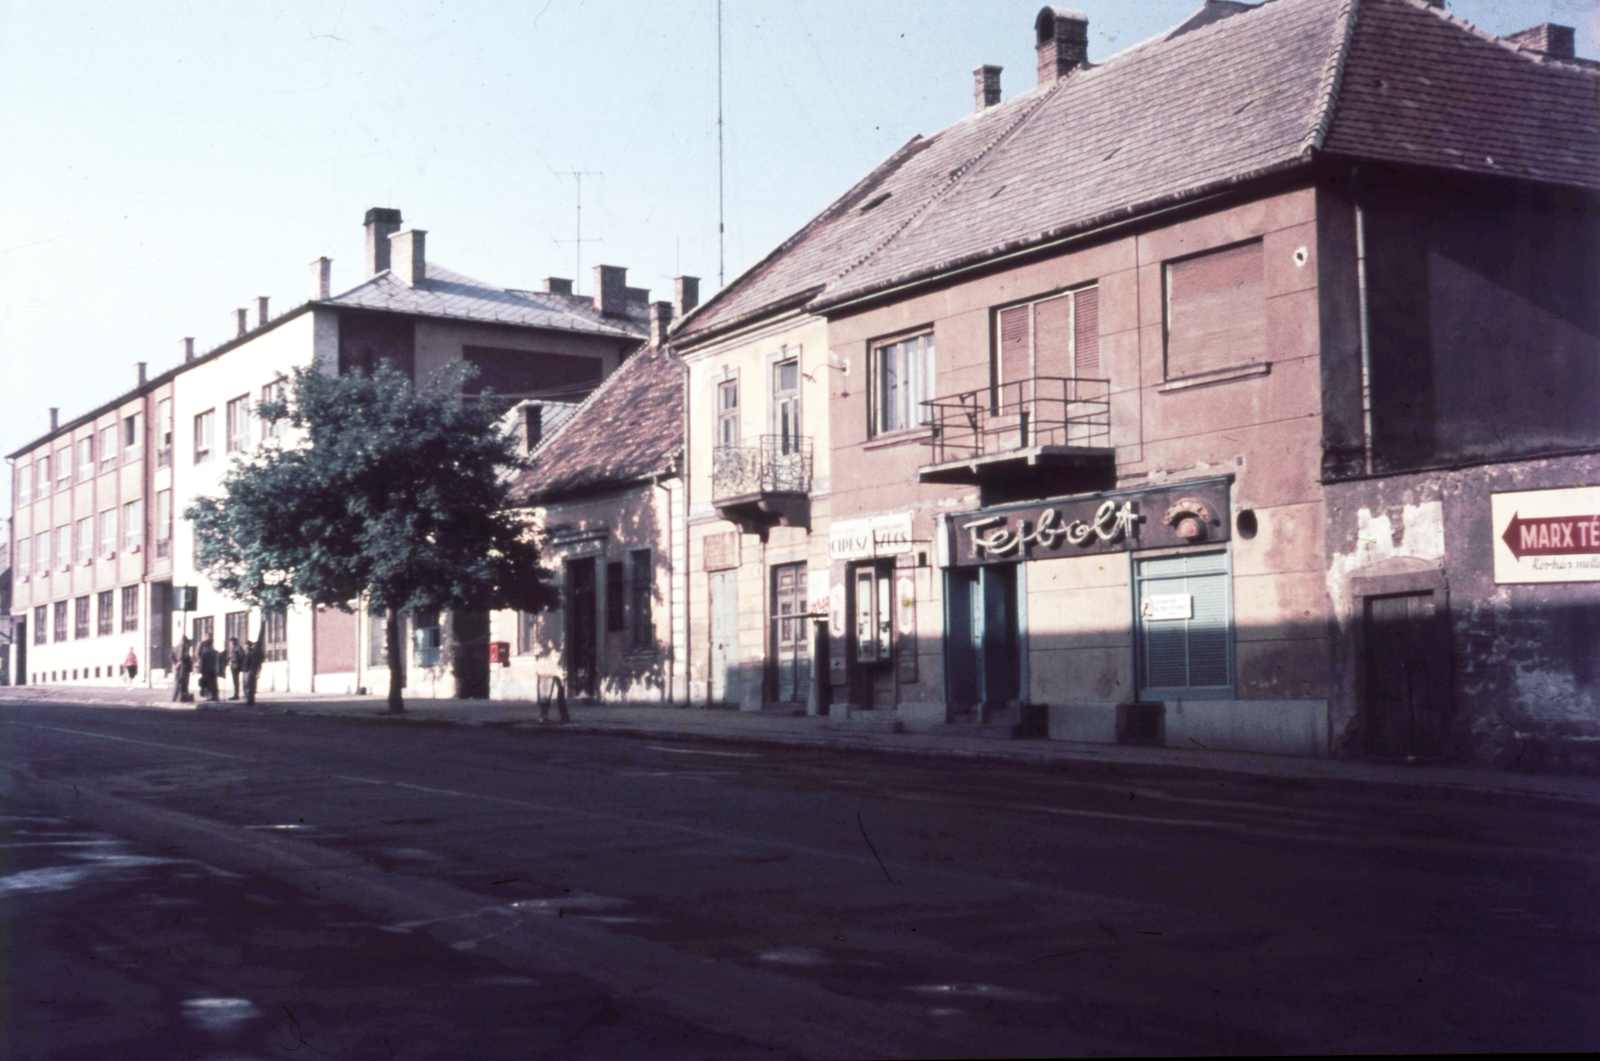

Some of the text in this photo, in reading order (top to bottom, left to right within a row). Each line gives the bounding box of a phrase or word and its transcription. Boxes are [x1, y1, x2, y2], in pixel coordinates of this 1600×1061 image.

[831, 535, 868, 552] CIPÉSZ
[1520, 515, 1600, 549] MARX TÉ
